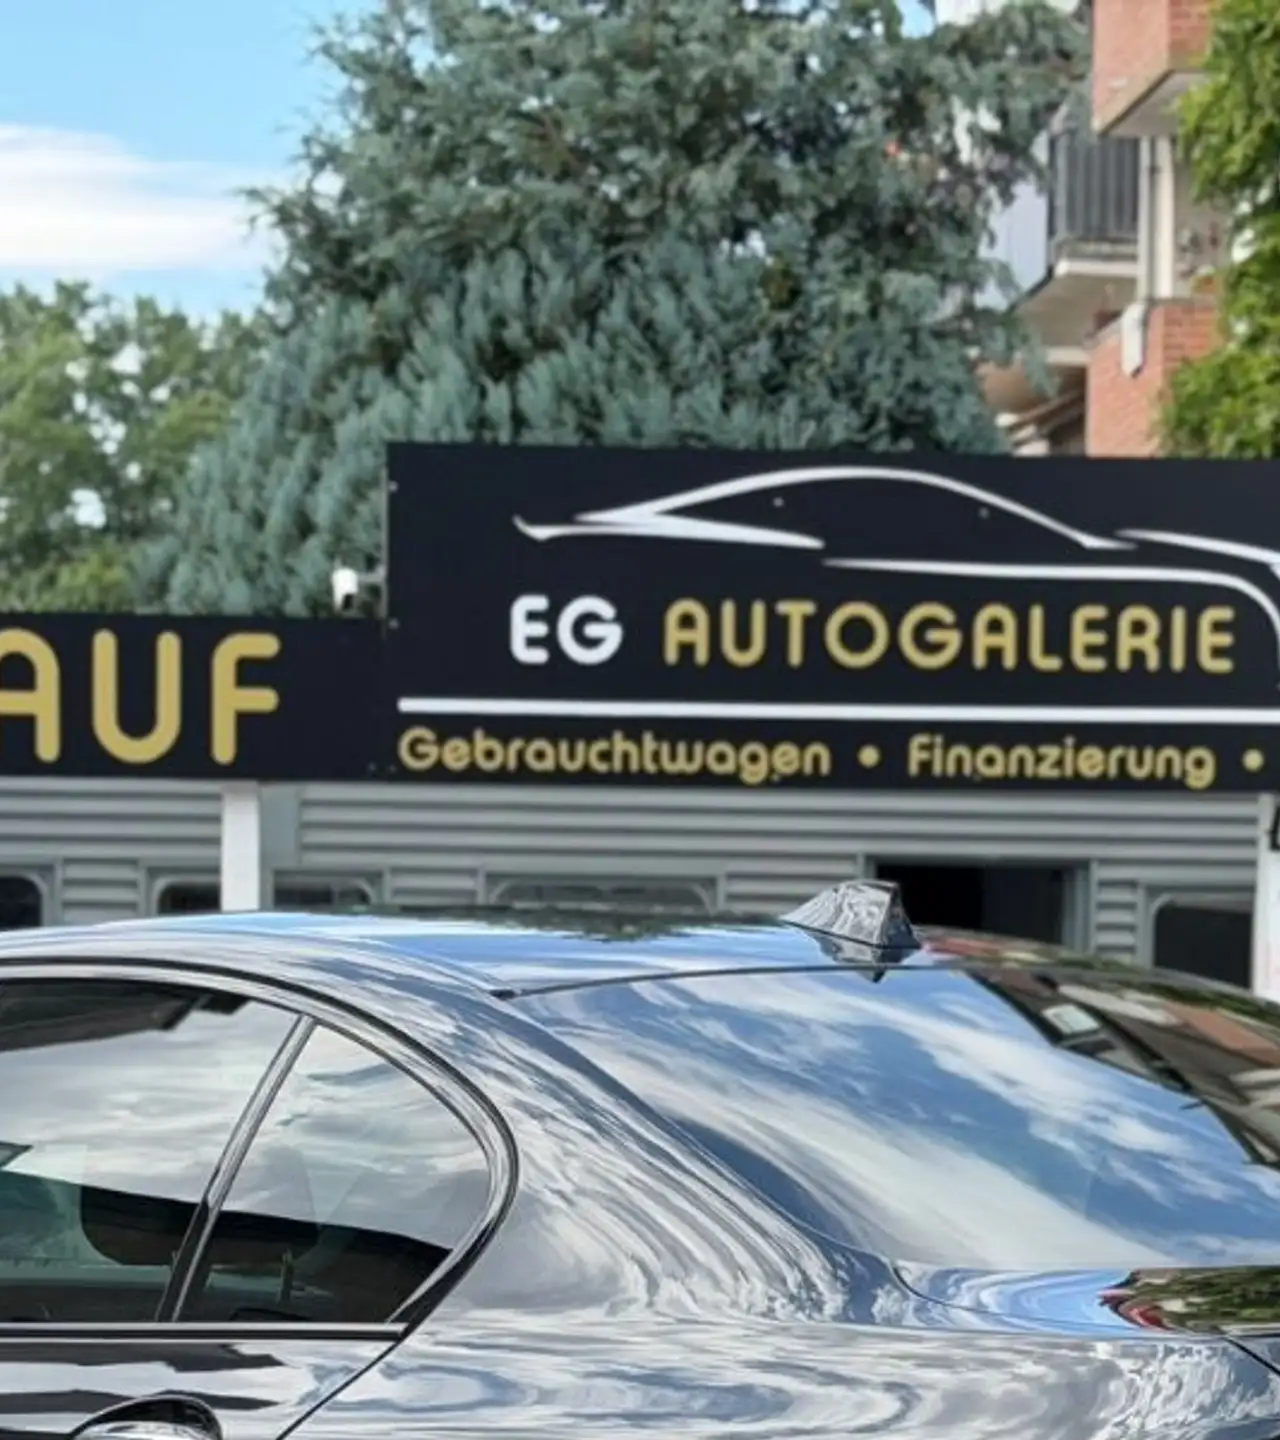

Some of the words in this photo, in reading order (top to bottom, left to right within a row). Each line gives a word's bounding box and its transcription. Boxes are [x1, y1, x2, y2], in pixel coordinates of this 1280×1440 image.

[510, 594, 623, 665] EG
[663, 598, 1236, 673] AUTOGALERIE
[397, 726, 832, 785] Gebrauchtwagen
[907, 733, 1217, 790] Finanzierung
